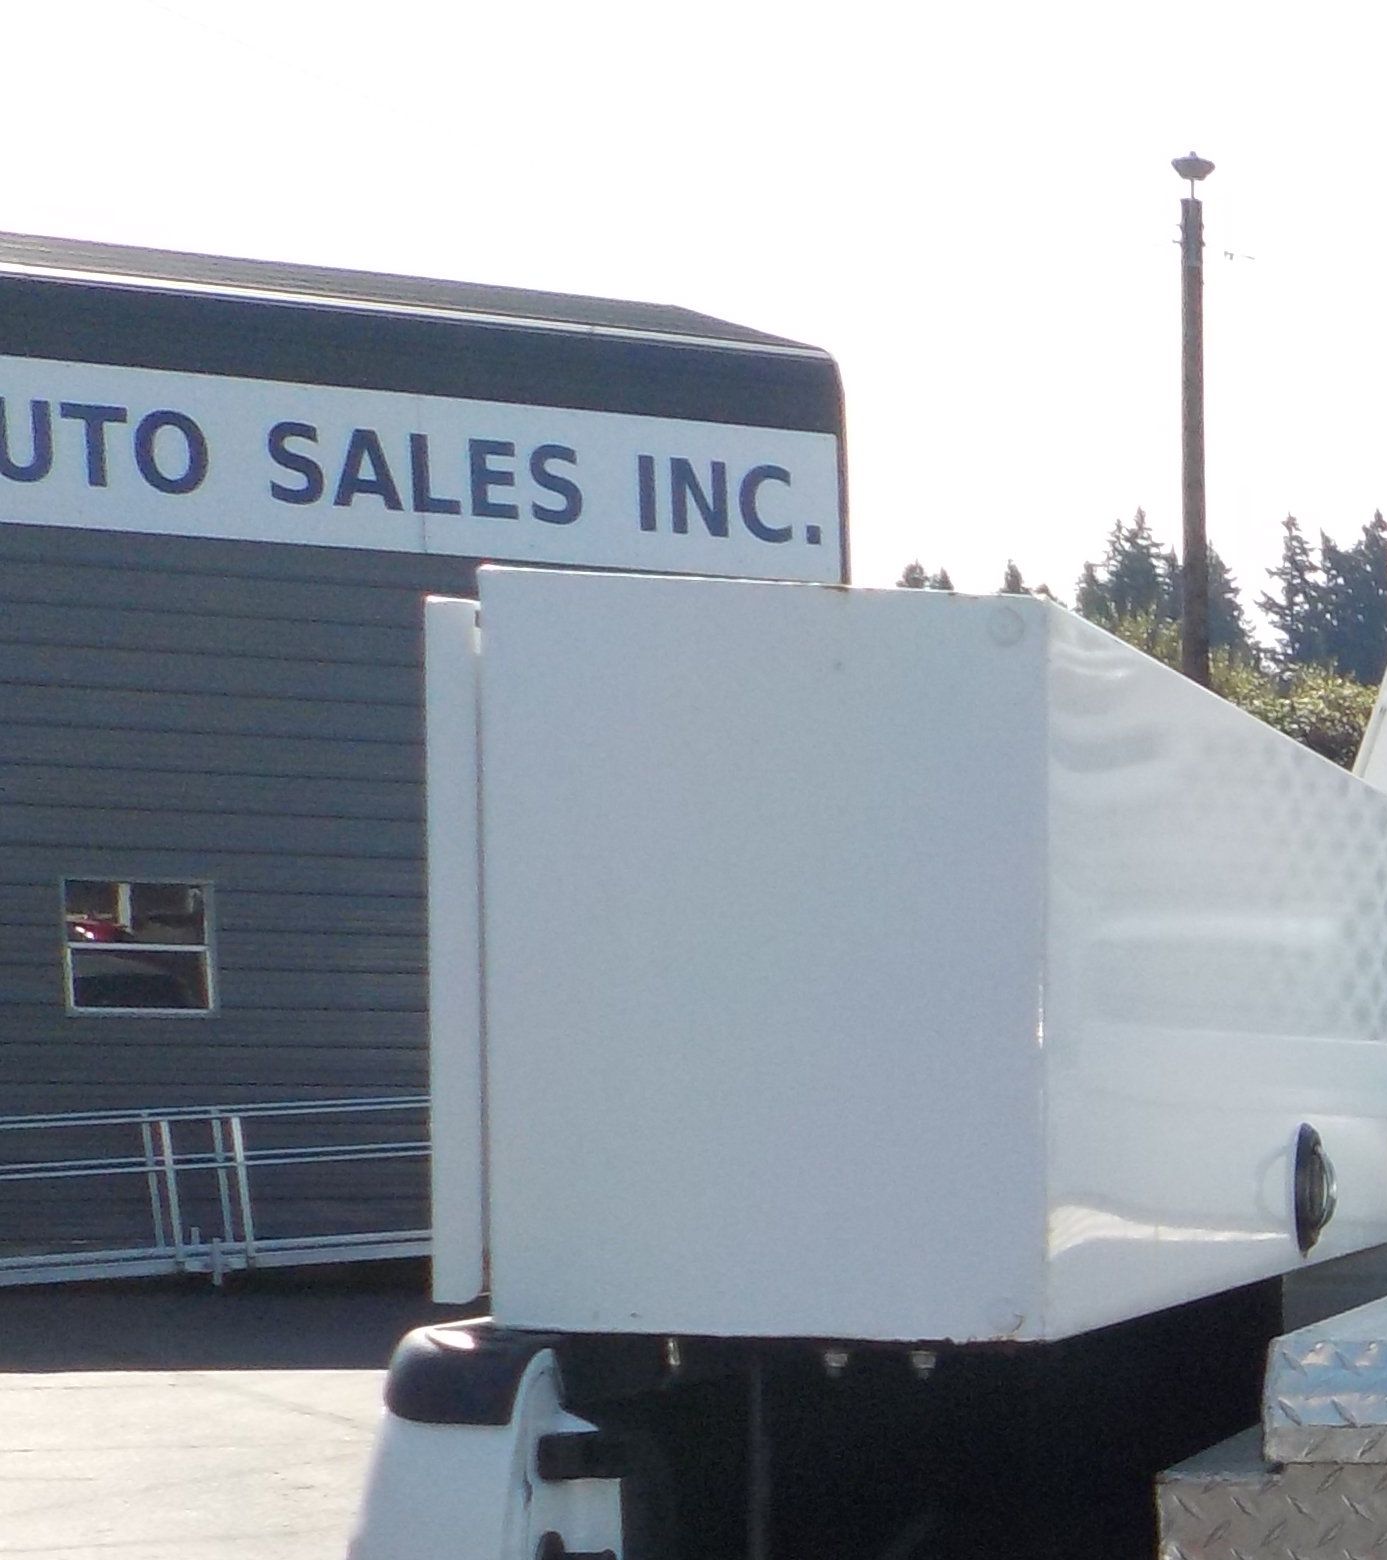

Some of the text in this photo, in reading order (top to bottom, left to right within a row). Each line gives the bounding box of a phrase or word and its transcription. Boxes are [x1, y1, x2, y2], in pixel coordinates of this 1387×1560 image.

[0, 397, 822, 545] UTO SALES INC.
